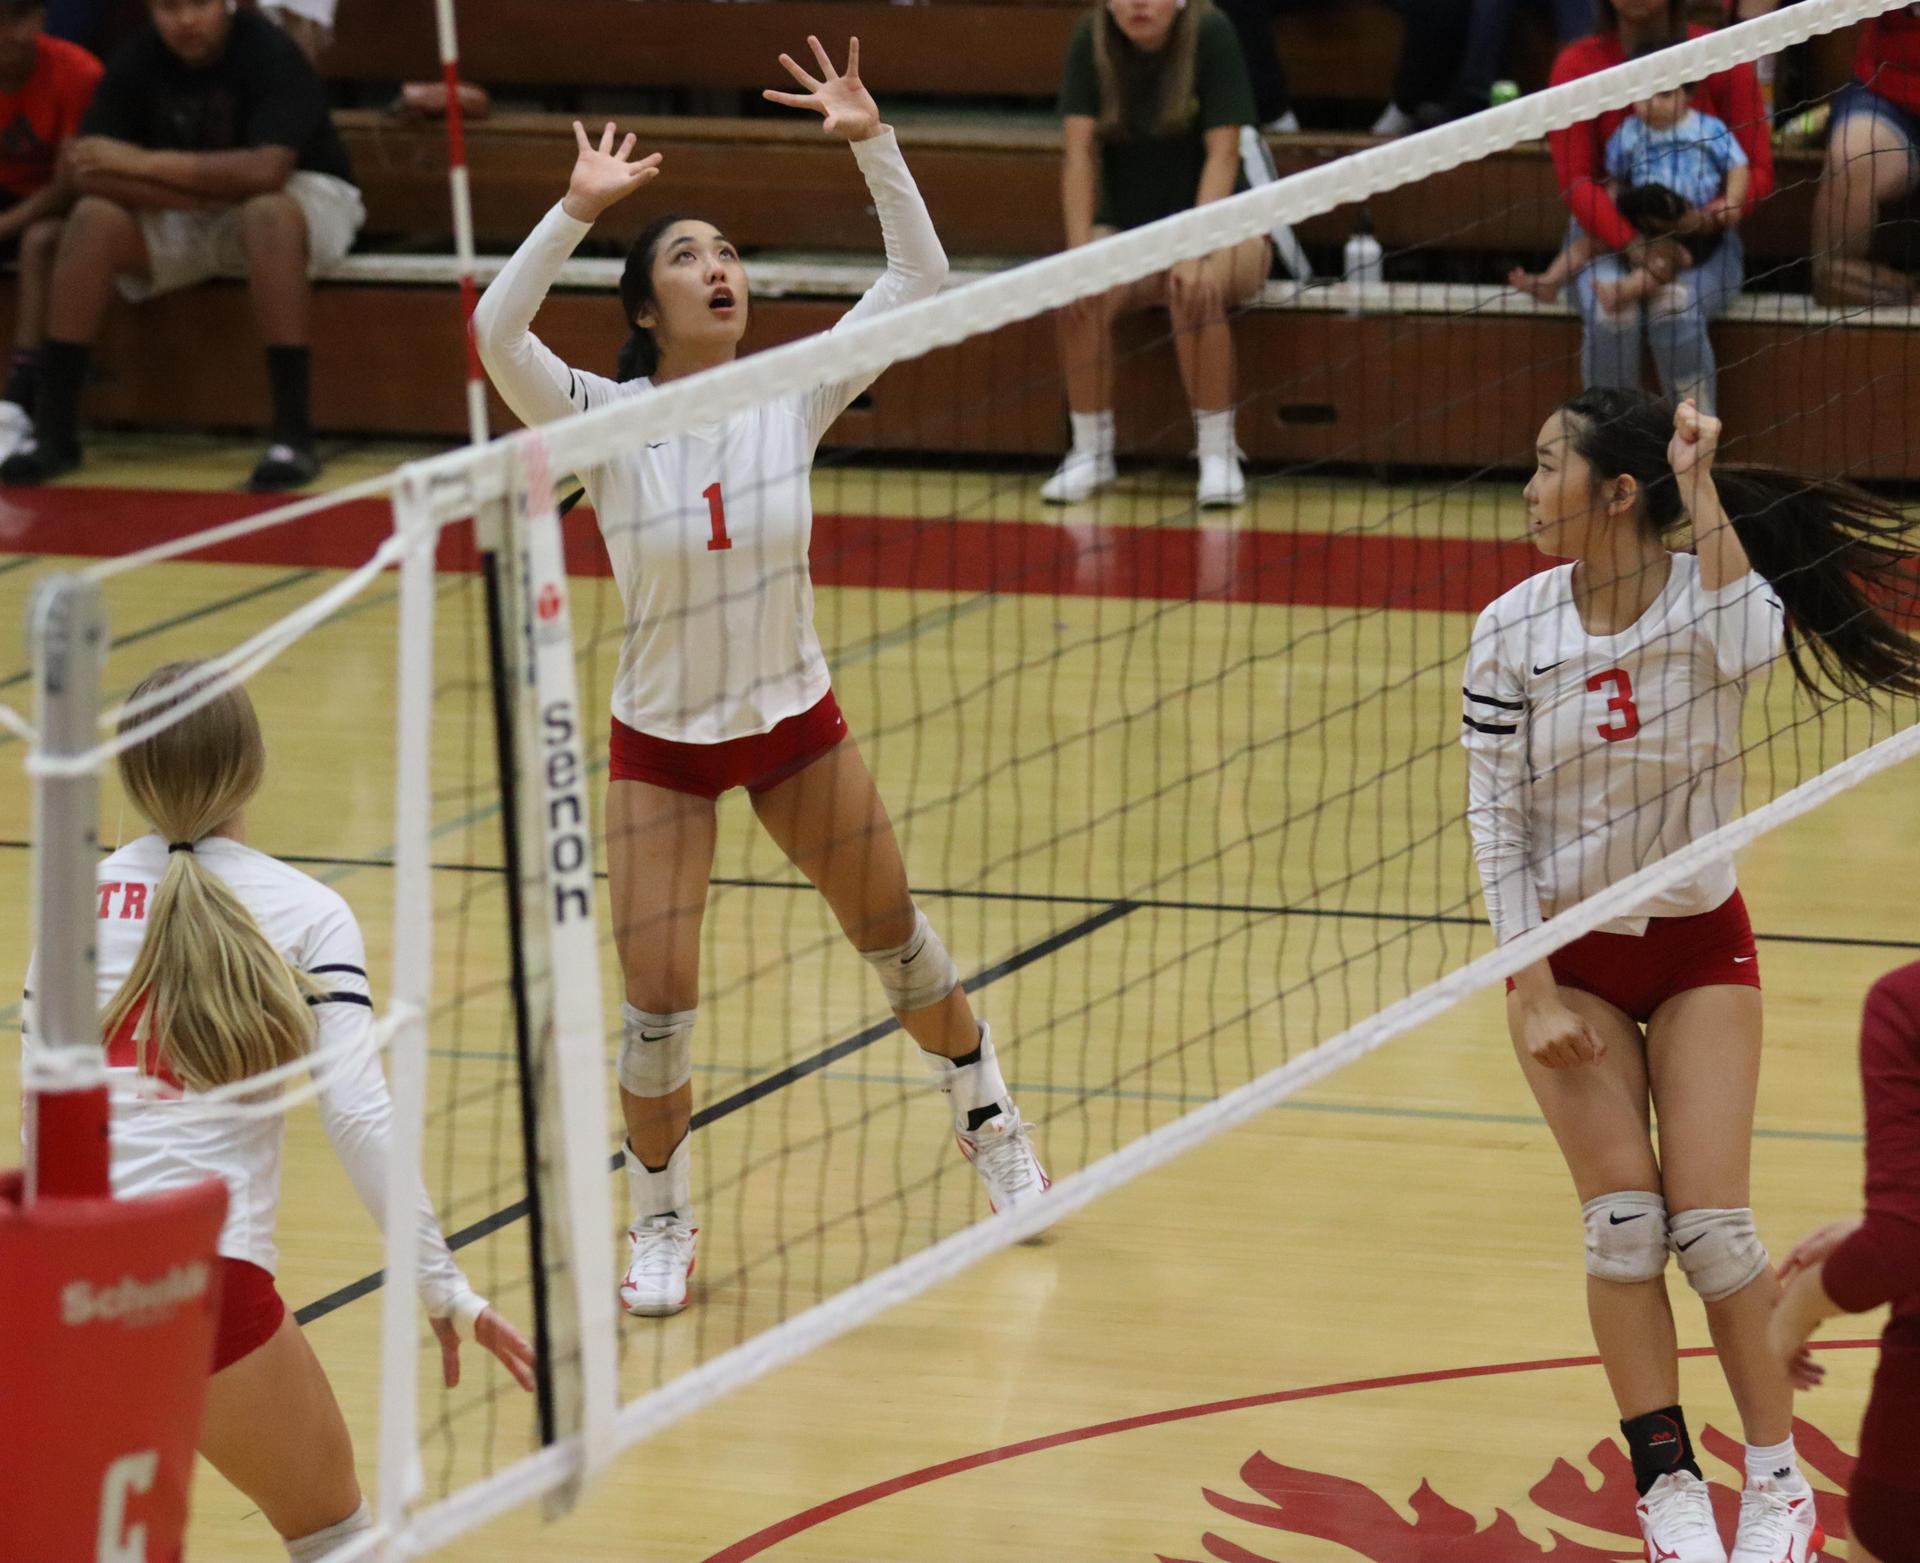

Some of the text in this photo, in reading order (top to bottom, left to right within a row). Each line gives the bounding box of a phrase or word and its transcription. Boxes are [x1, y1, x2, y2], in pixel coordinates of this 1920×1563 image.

[702, 482, 732, 551] 1
[1585, 667, 1641, 743] 3
[96, 882, 158, 919] TR
